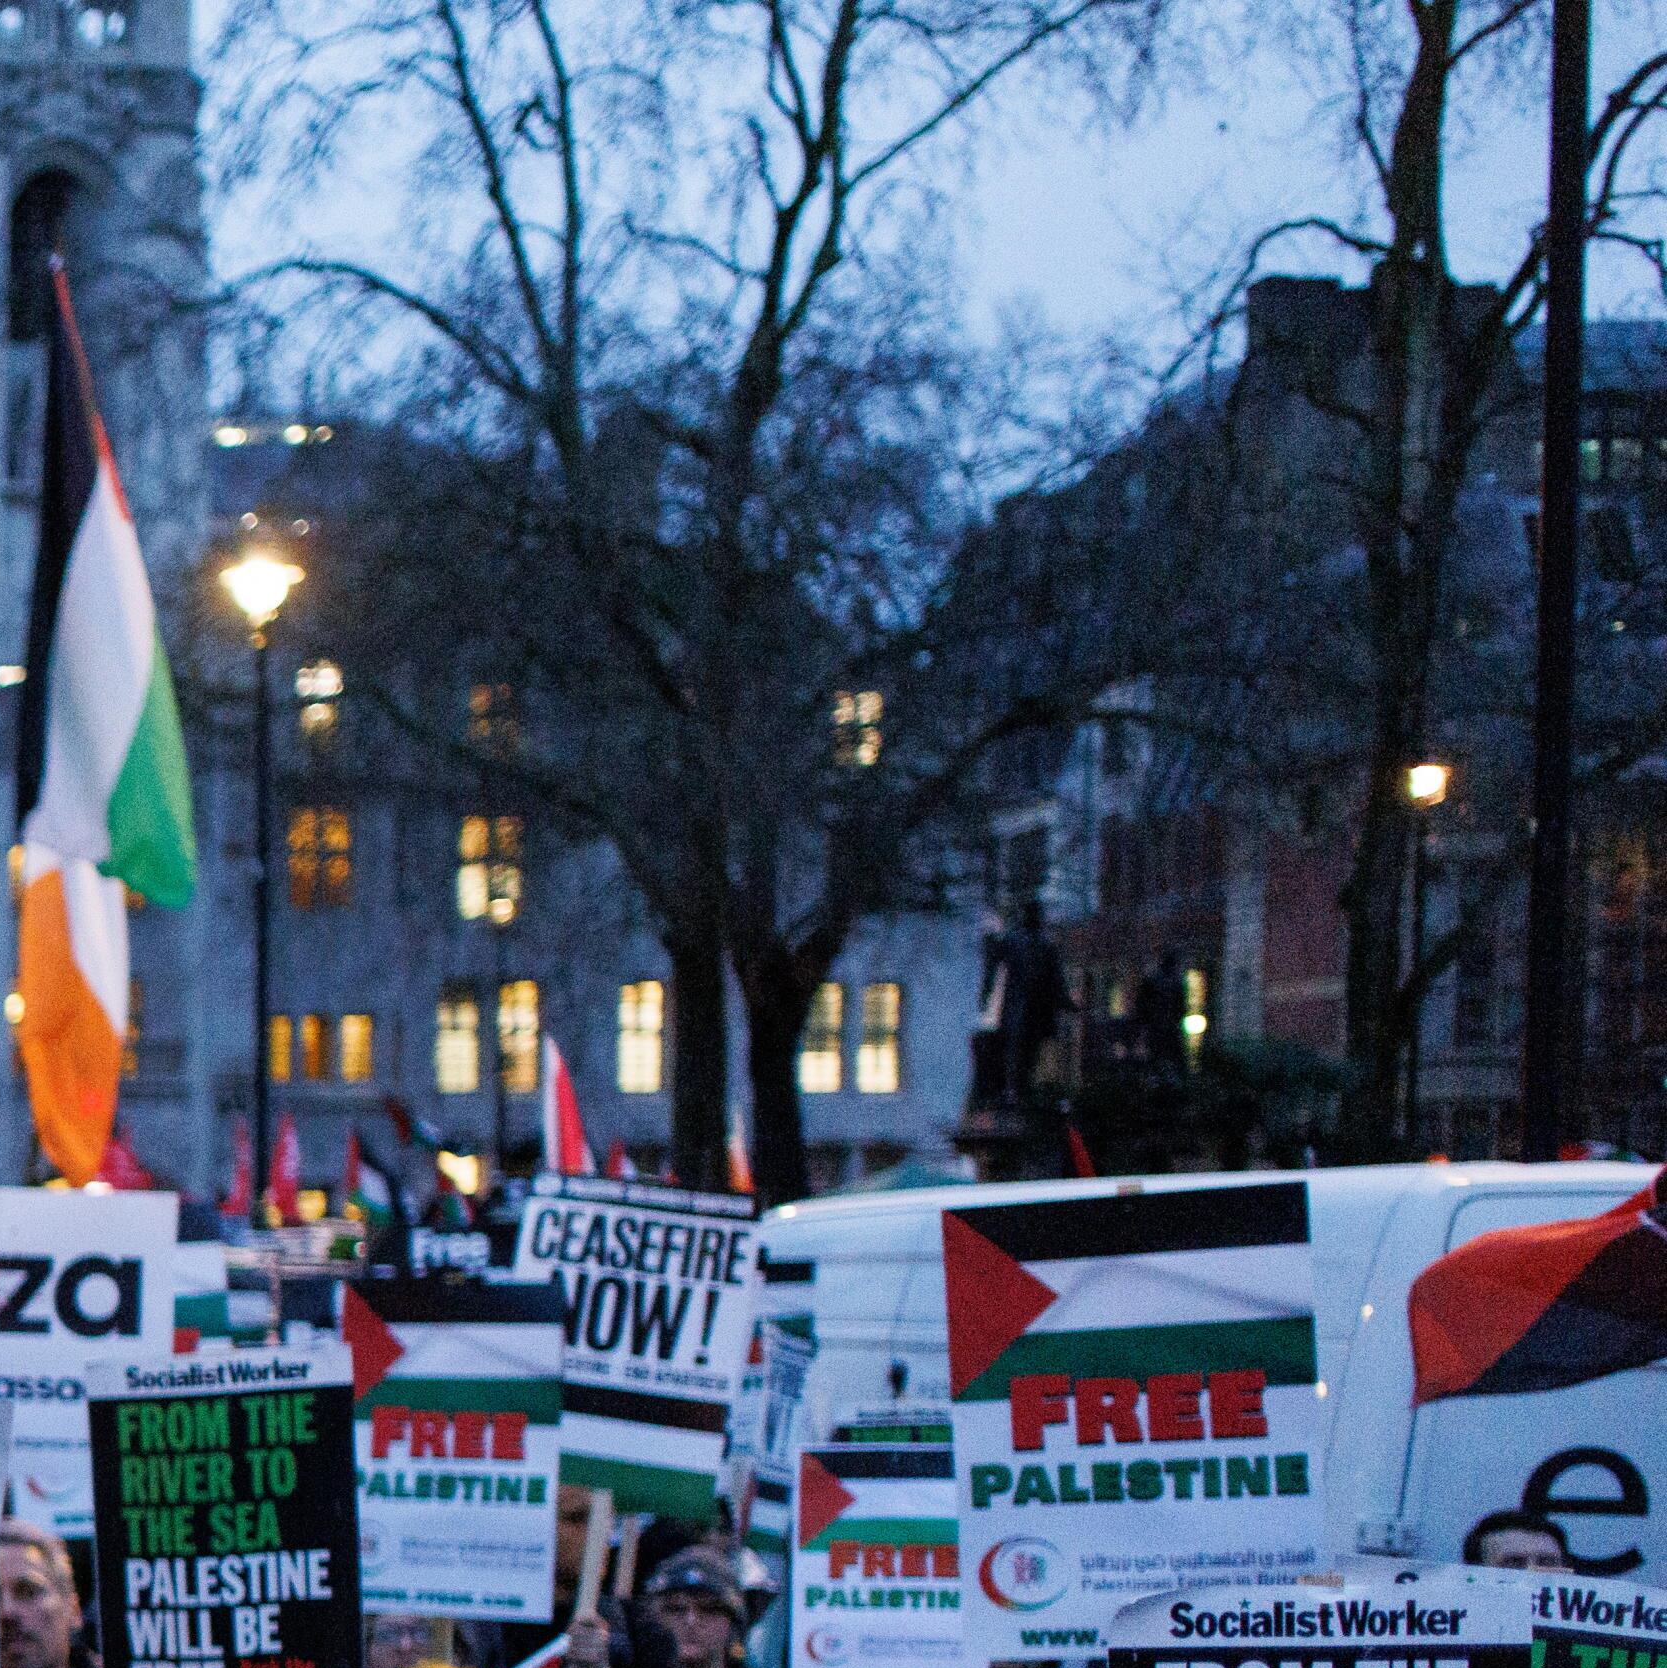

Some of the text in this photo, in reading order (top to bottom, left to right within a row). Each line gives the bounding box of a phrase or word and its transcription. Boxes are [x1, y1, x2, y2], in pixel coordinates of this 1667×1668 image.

[532, 1208, 749, 1284] CEASEFIRE
[124, 1360, 312, 1390] Socialist Worker
[117, 1392, 317, 1453] FROM THE
[371, 1405, 528, 1461] FREE
[1009, 1369, 1269, 1451] FREE
[121, 1447, 298, 1505] RIVER TO
[970, 1452, 1311, 1510] PALESTINE
[122, 1500, 282, 1555] THE SEA
[125, 1548, 333, 1608] PALESTINE
[829, 1540, 960, 1580] FREE
[126, 1603, 283, 1659] WILL BE
[1170, 1600, 1467, 1640] Socialist Worker
